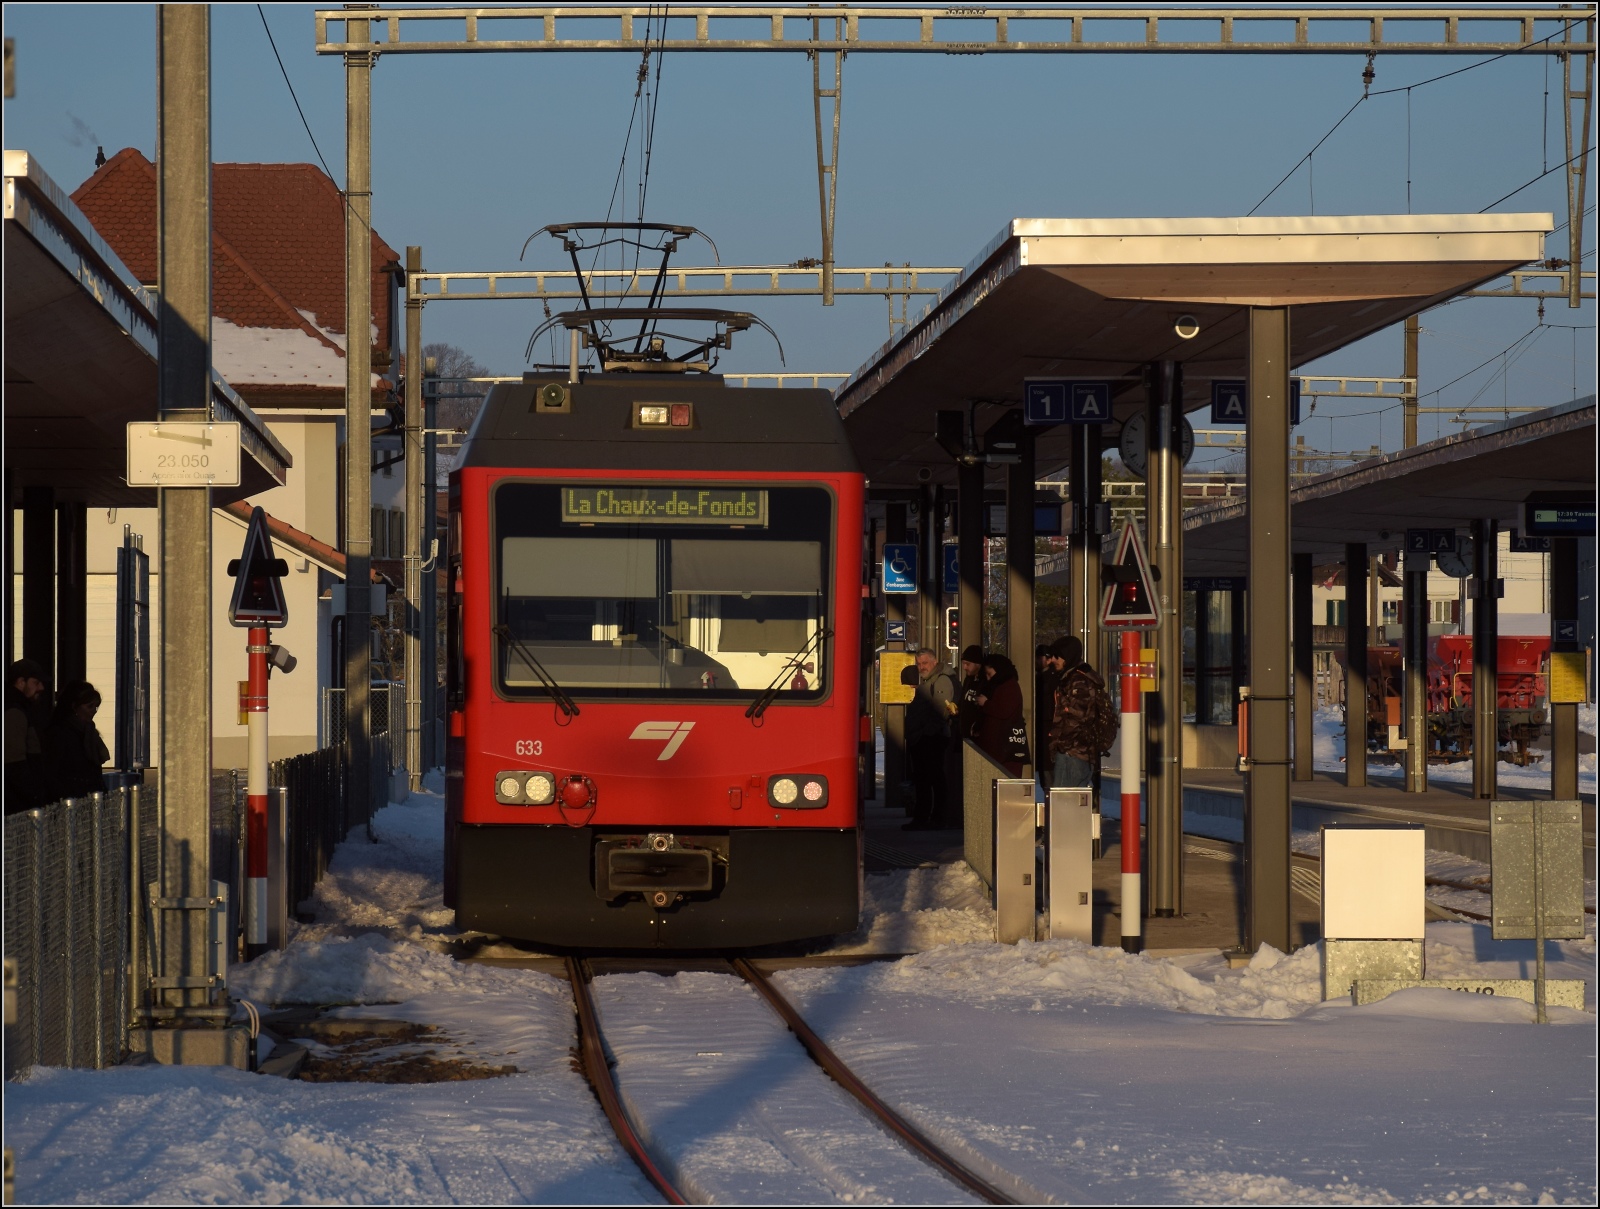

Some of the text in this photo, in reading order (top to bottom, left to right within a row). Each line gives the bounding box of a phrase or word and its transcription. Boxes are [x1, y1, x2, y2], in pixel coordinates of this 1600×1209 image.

[1041, 395, 1051, 416] 1
[1081, 394, 1101, 415] A
[1224, 394, 1244, 415] A
[158, 455, 209, 468] 23.050
[569, 489, 757, 517] La Chaux-de-Fonds
[1415, 536, 1424, 549] 2
[1438, 536, 1449, 549] A
[1517, 537, 1528, 548] A
[1542, 537, 1551, 548] 3
[515, 740, 543, 756] 633
